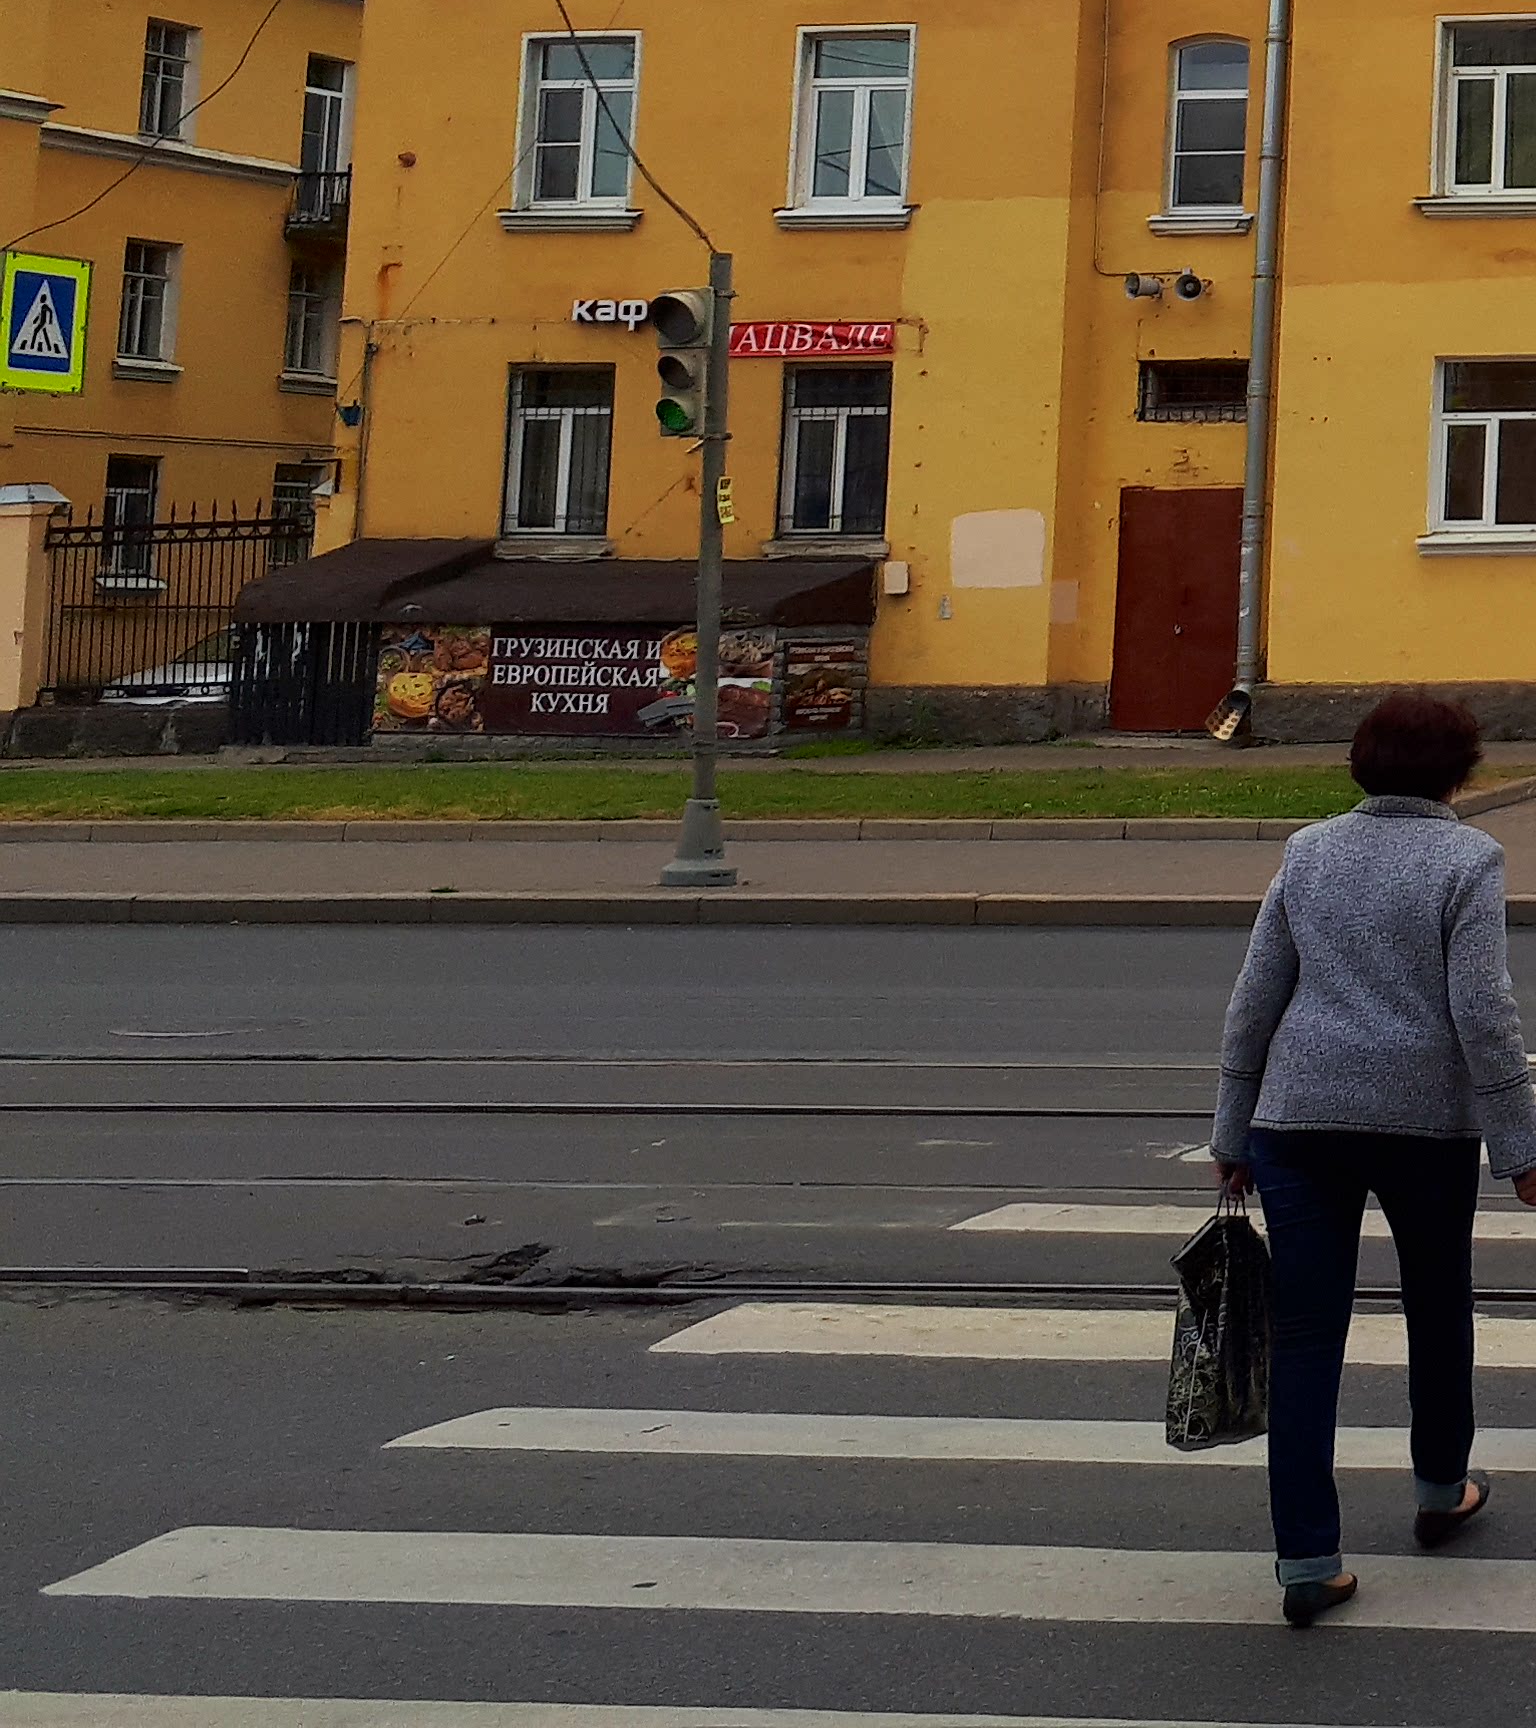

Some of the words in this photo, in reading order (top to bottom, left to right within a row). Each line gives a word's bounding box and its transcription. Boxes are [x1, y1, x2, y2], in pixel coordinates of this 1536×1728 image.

[491, 637, 640, 660] ГРУЗИНСКАЯ
[644, 640, 662, 660] И
[491, 661, 659, 687] ЕВРОПЕЙСКАЯ
[530, 692, 610, 713] КУХНЯ
